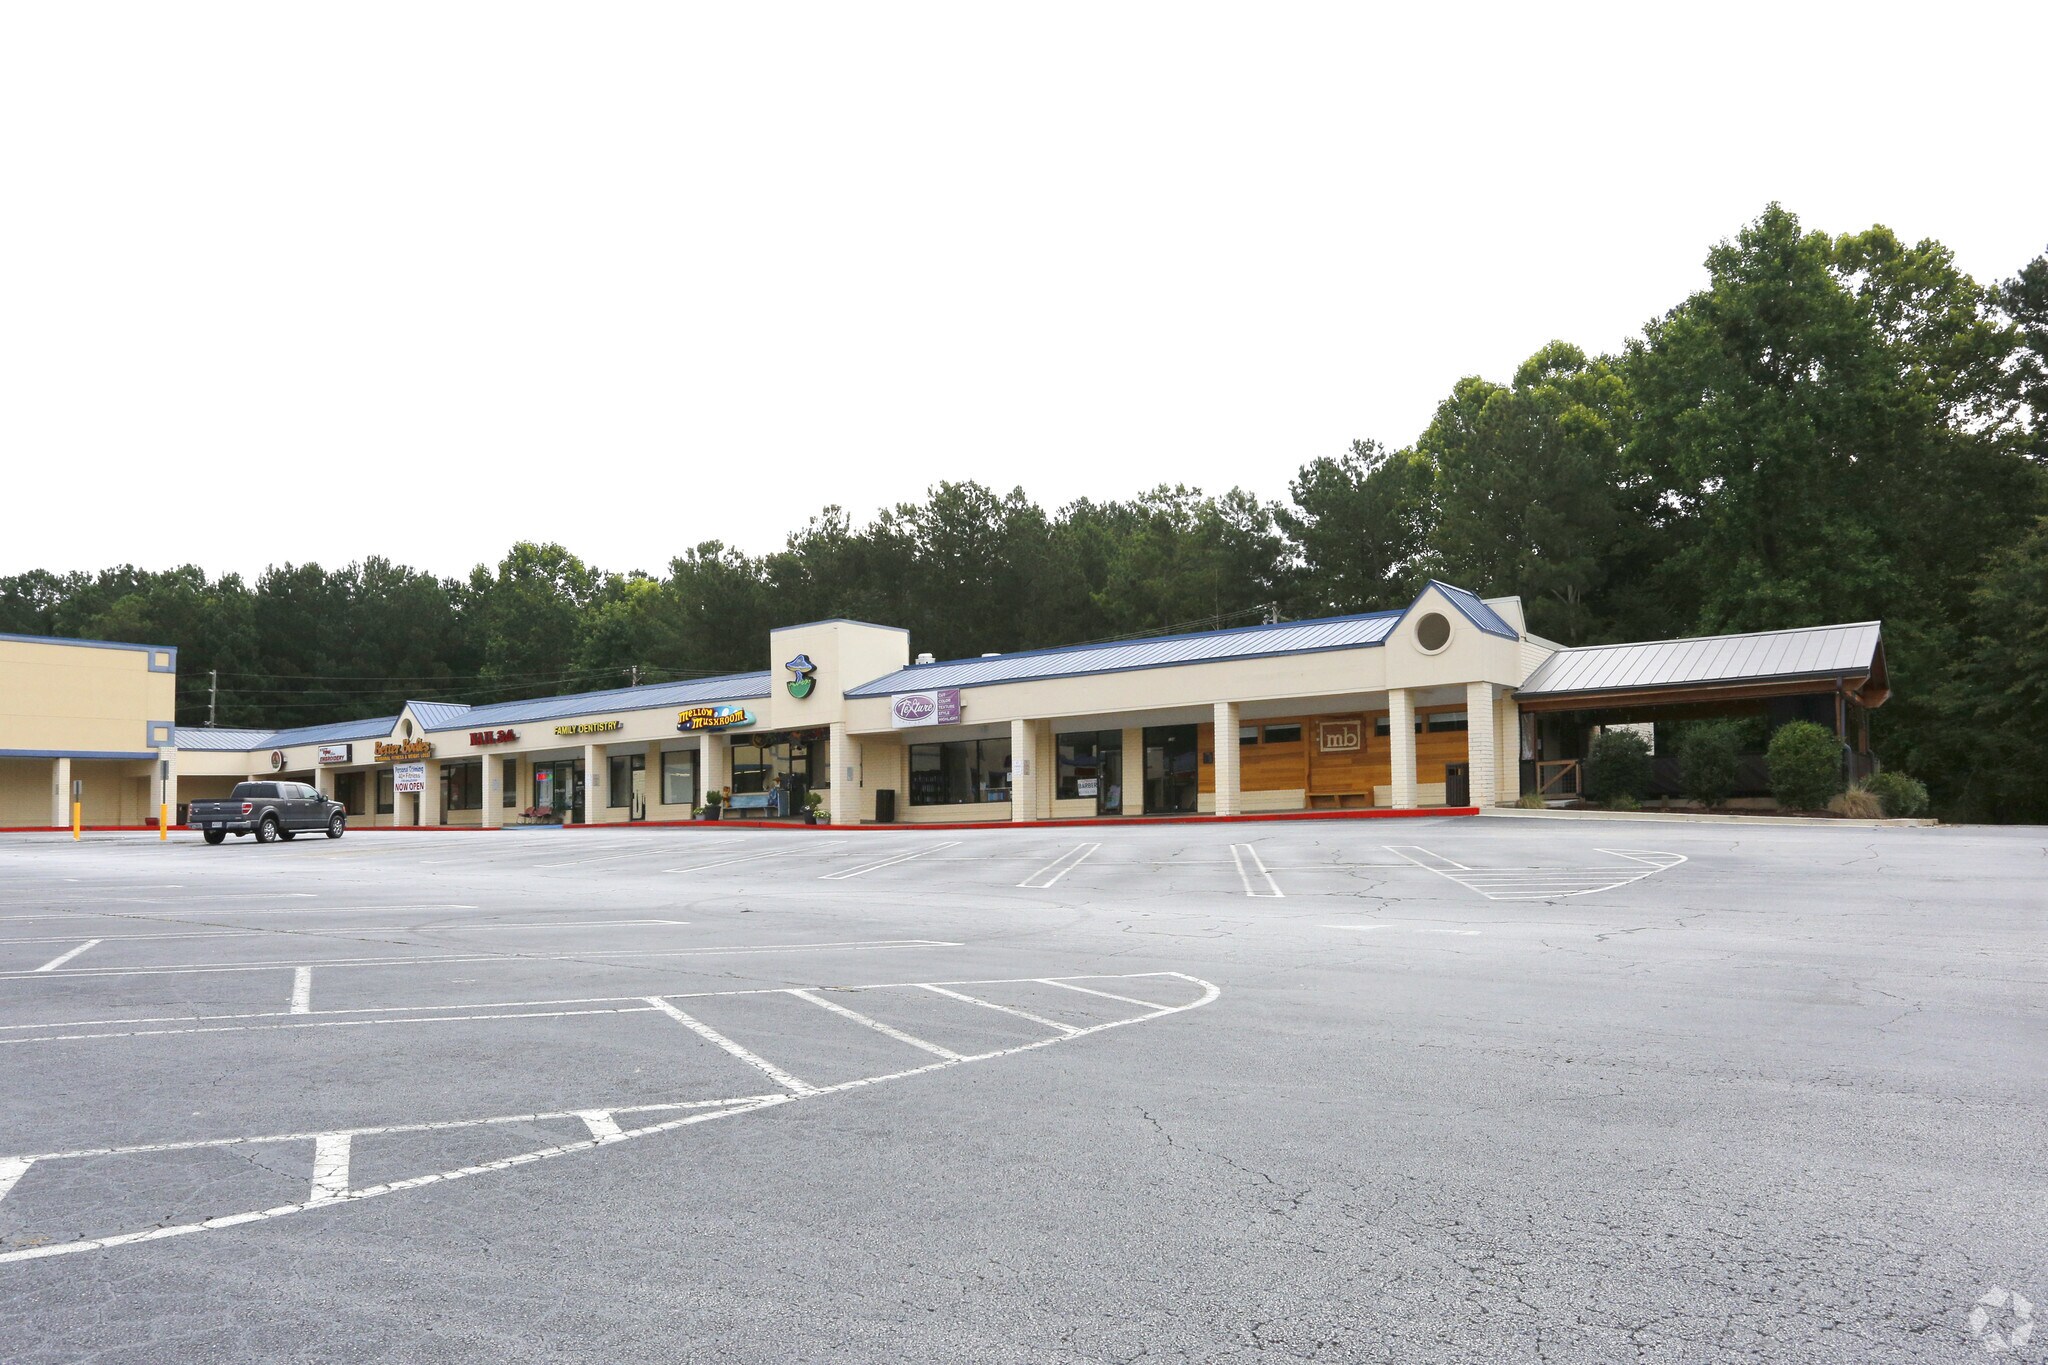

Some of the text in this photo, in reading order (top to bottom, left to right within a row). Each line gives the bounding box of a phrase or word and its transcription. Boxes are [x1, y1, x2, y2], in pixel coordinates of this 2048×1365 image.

[691, 709, 745, 729] MUSHROOM
[554, 721, 619, 736] FAMILY DENTISTRY
[469, 731, 495, 746] NAIL
[1326, 726, 1358, 748] mb
[374, 738, 431, 756] Better Bodies
[395, 782, 425, 791] NOW OPEN
